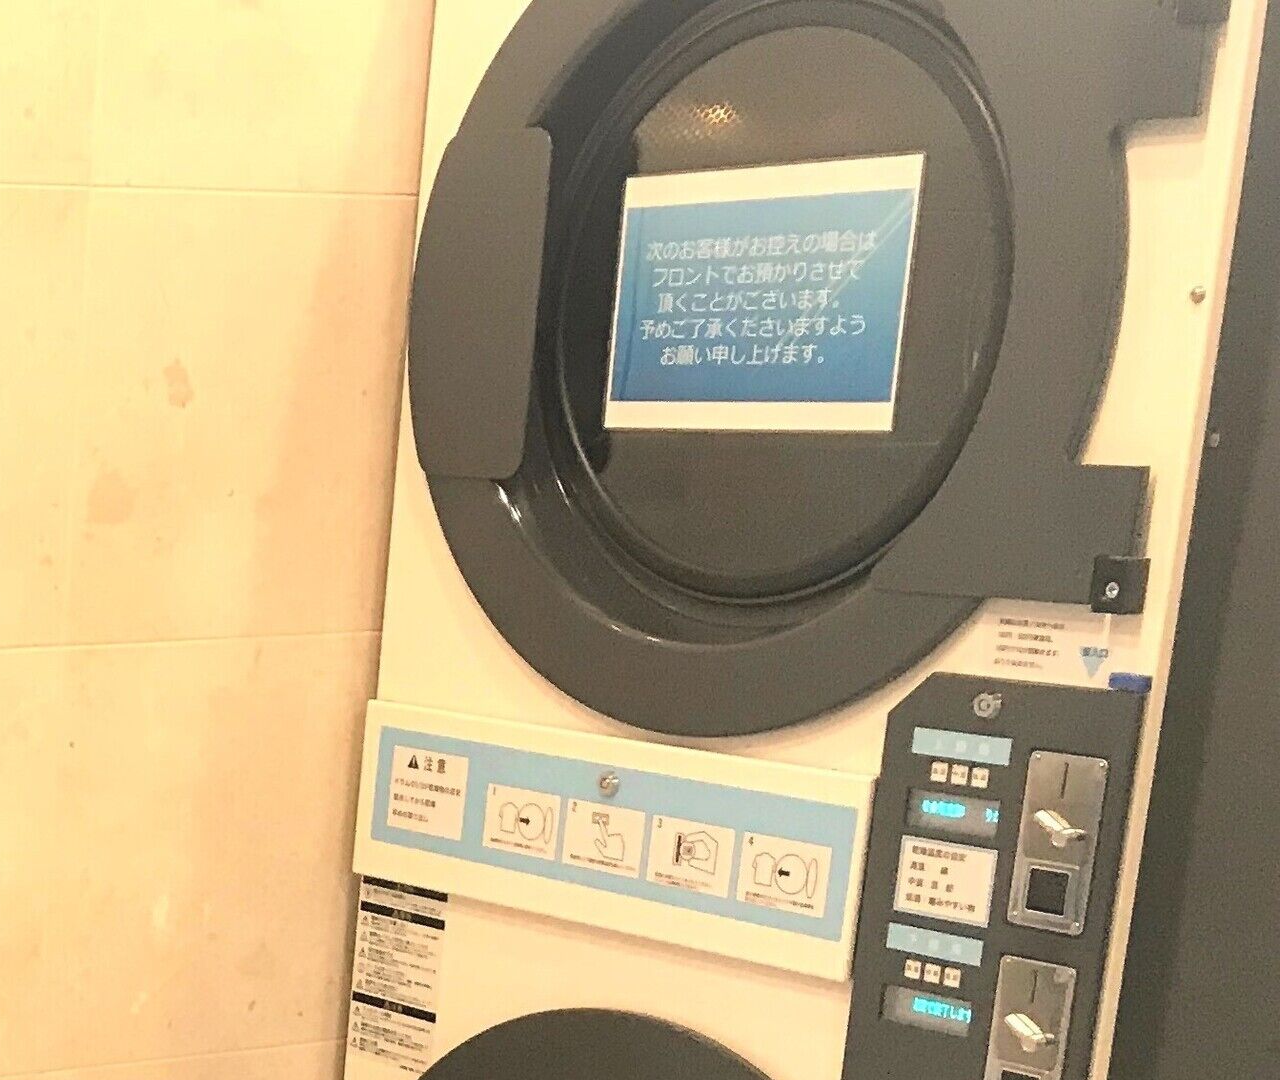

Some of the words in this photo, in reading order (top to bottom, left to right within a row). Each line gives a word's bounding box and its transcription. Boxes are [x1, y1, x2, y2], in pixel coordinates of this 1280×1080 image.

[646, 229, 877, 261] 次のお客様がお控えの場合は
[652, 258, 865, 288] フロントでお預かりさせて
